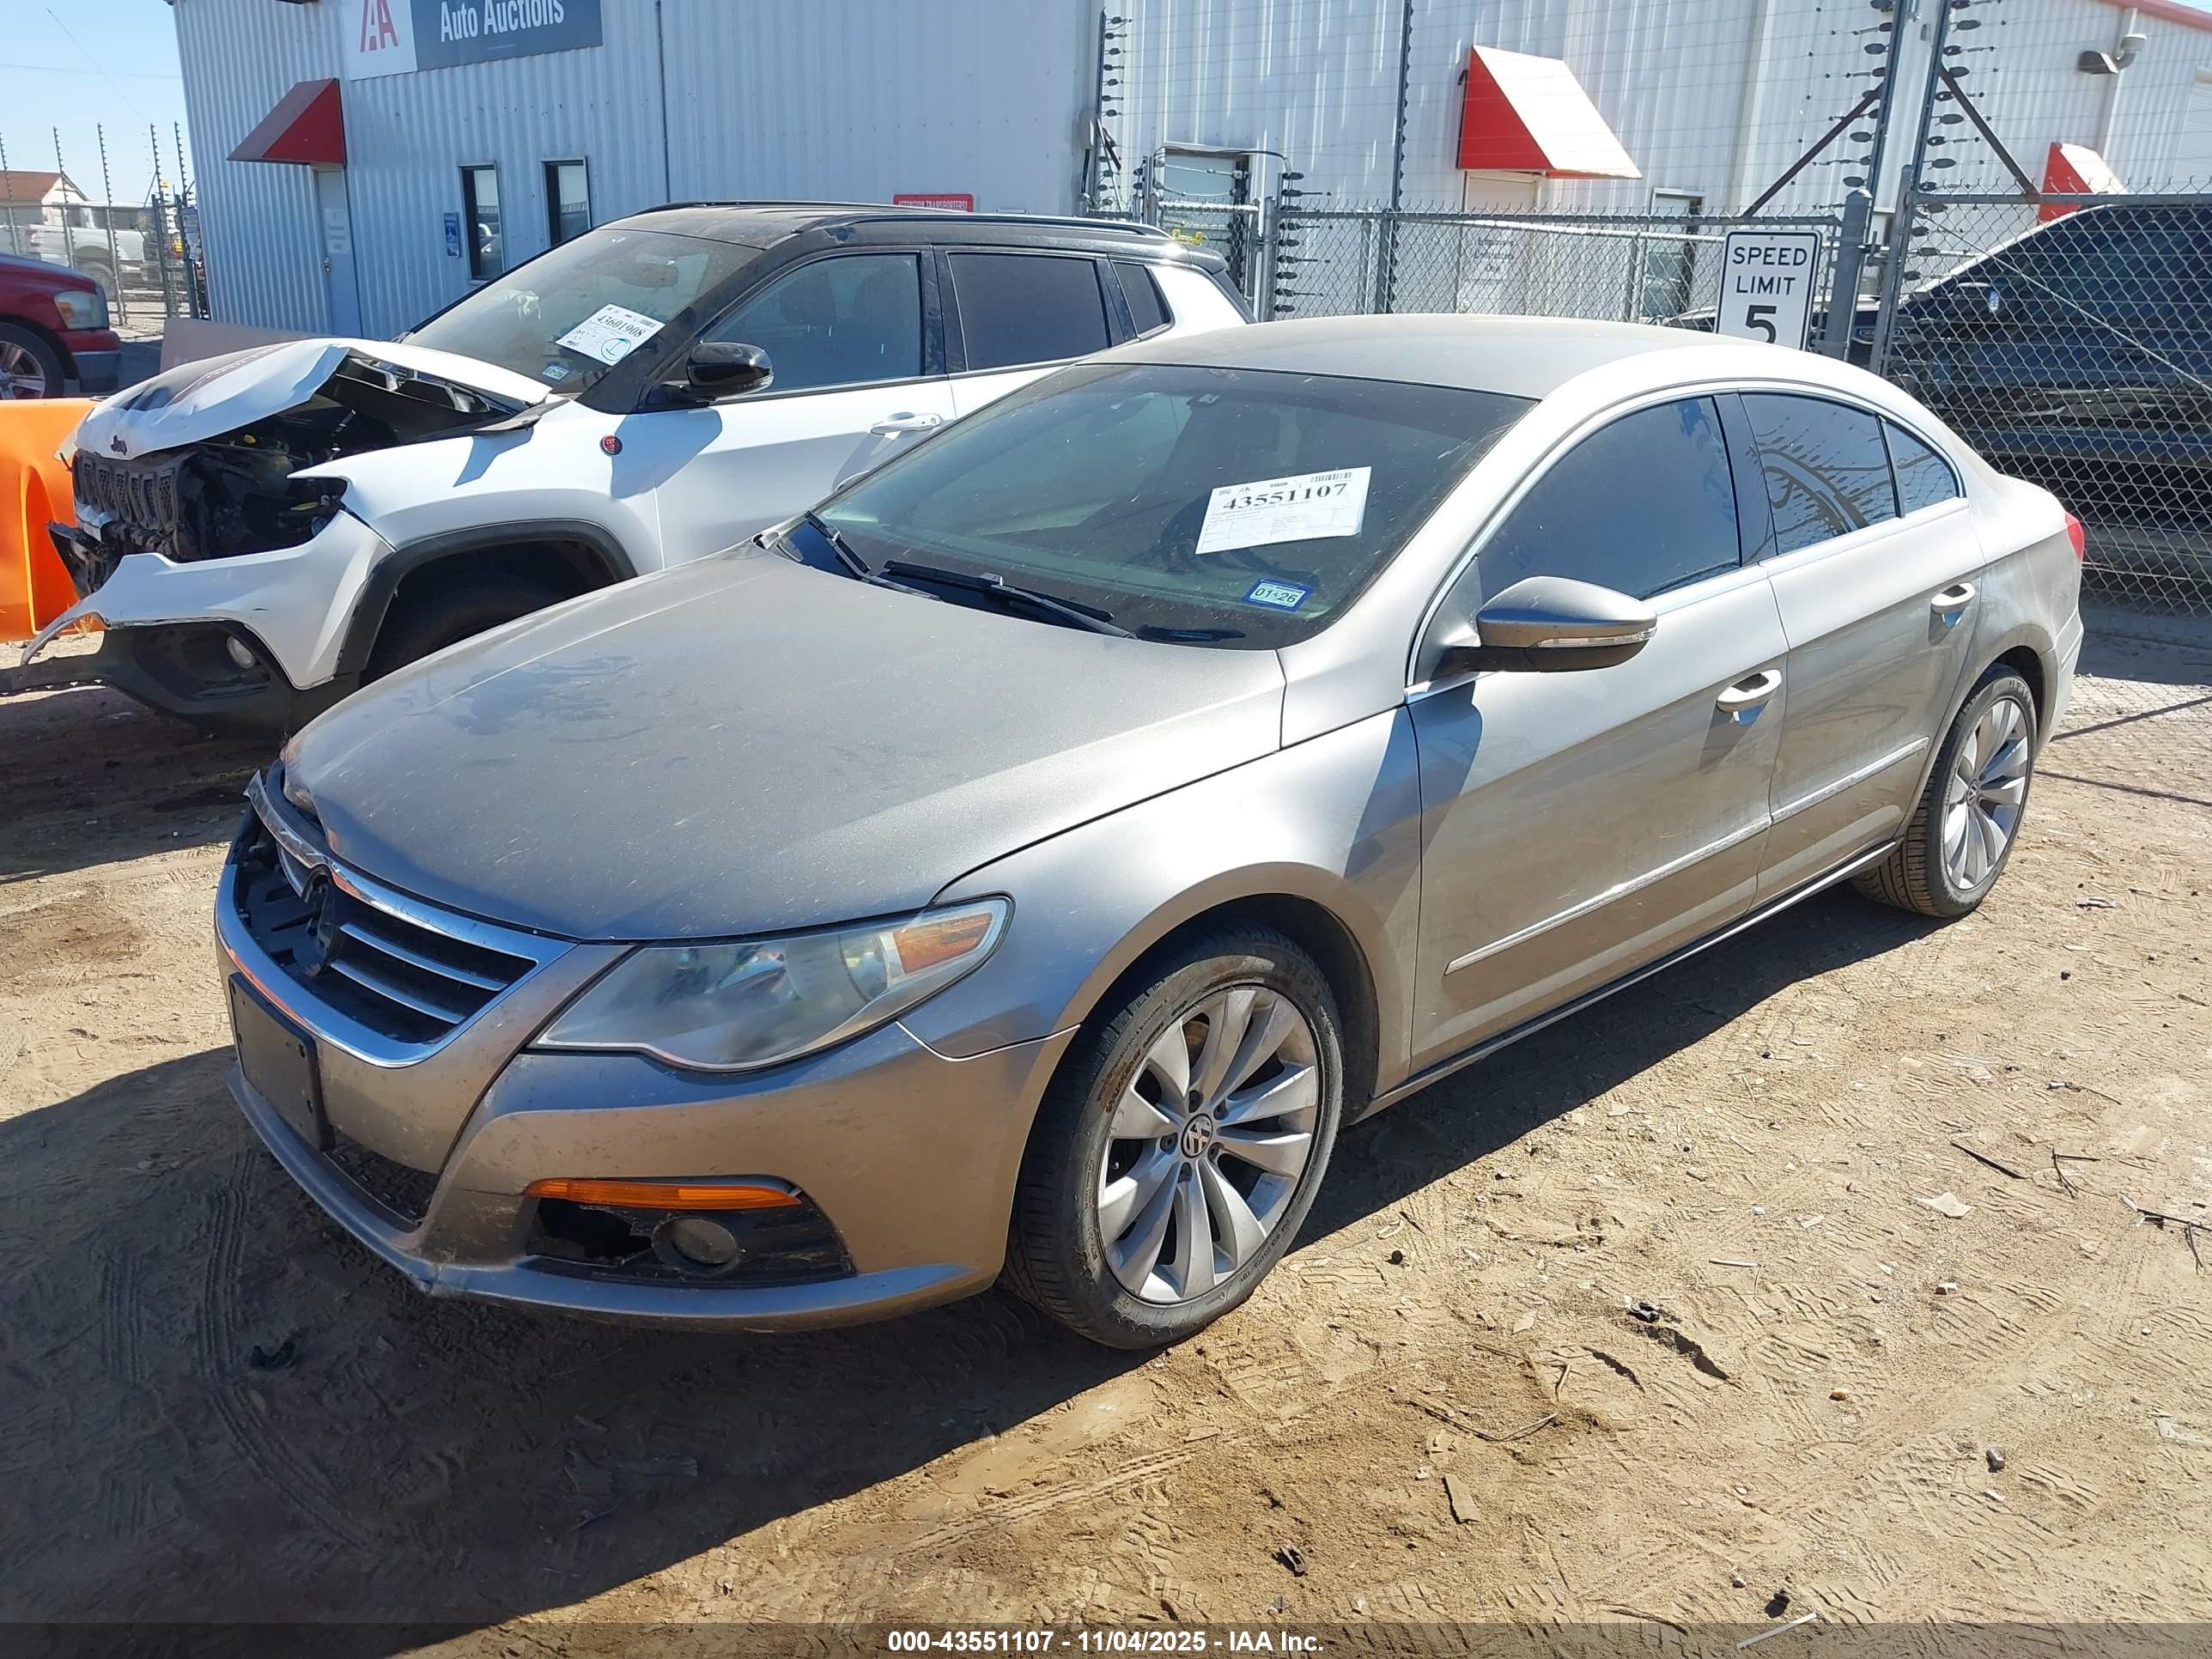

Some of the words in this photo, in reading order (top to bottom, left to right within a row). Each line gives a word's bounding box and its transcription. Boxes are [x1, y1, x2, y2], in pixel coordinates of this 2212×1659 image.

[441, 2, 477, 42] Auto
[483, 0, 564, 35] Auctions
[1732, 246, 1808, 266] SPEED
[1736, 276, 1796, 295] LIMIT
[597, 314, 646, 337] 43601908
[1745, 305, 1777, 343] 5
[1223, 483, 1347, 509] 43551107
